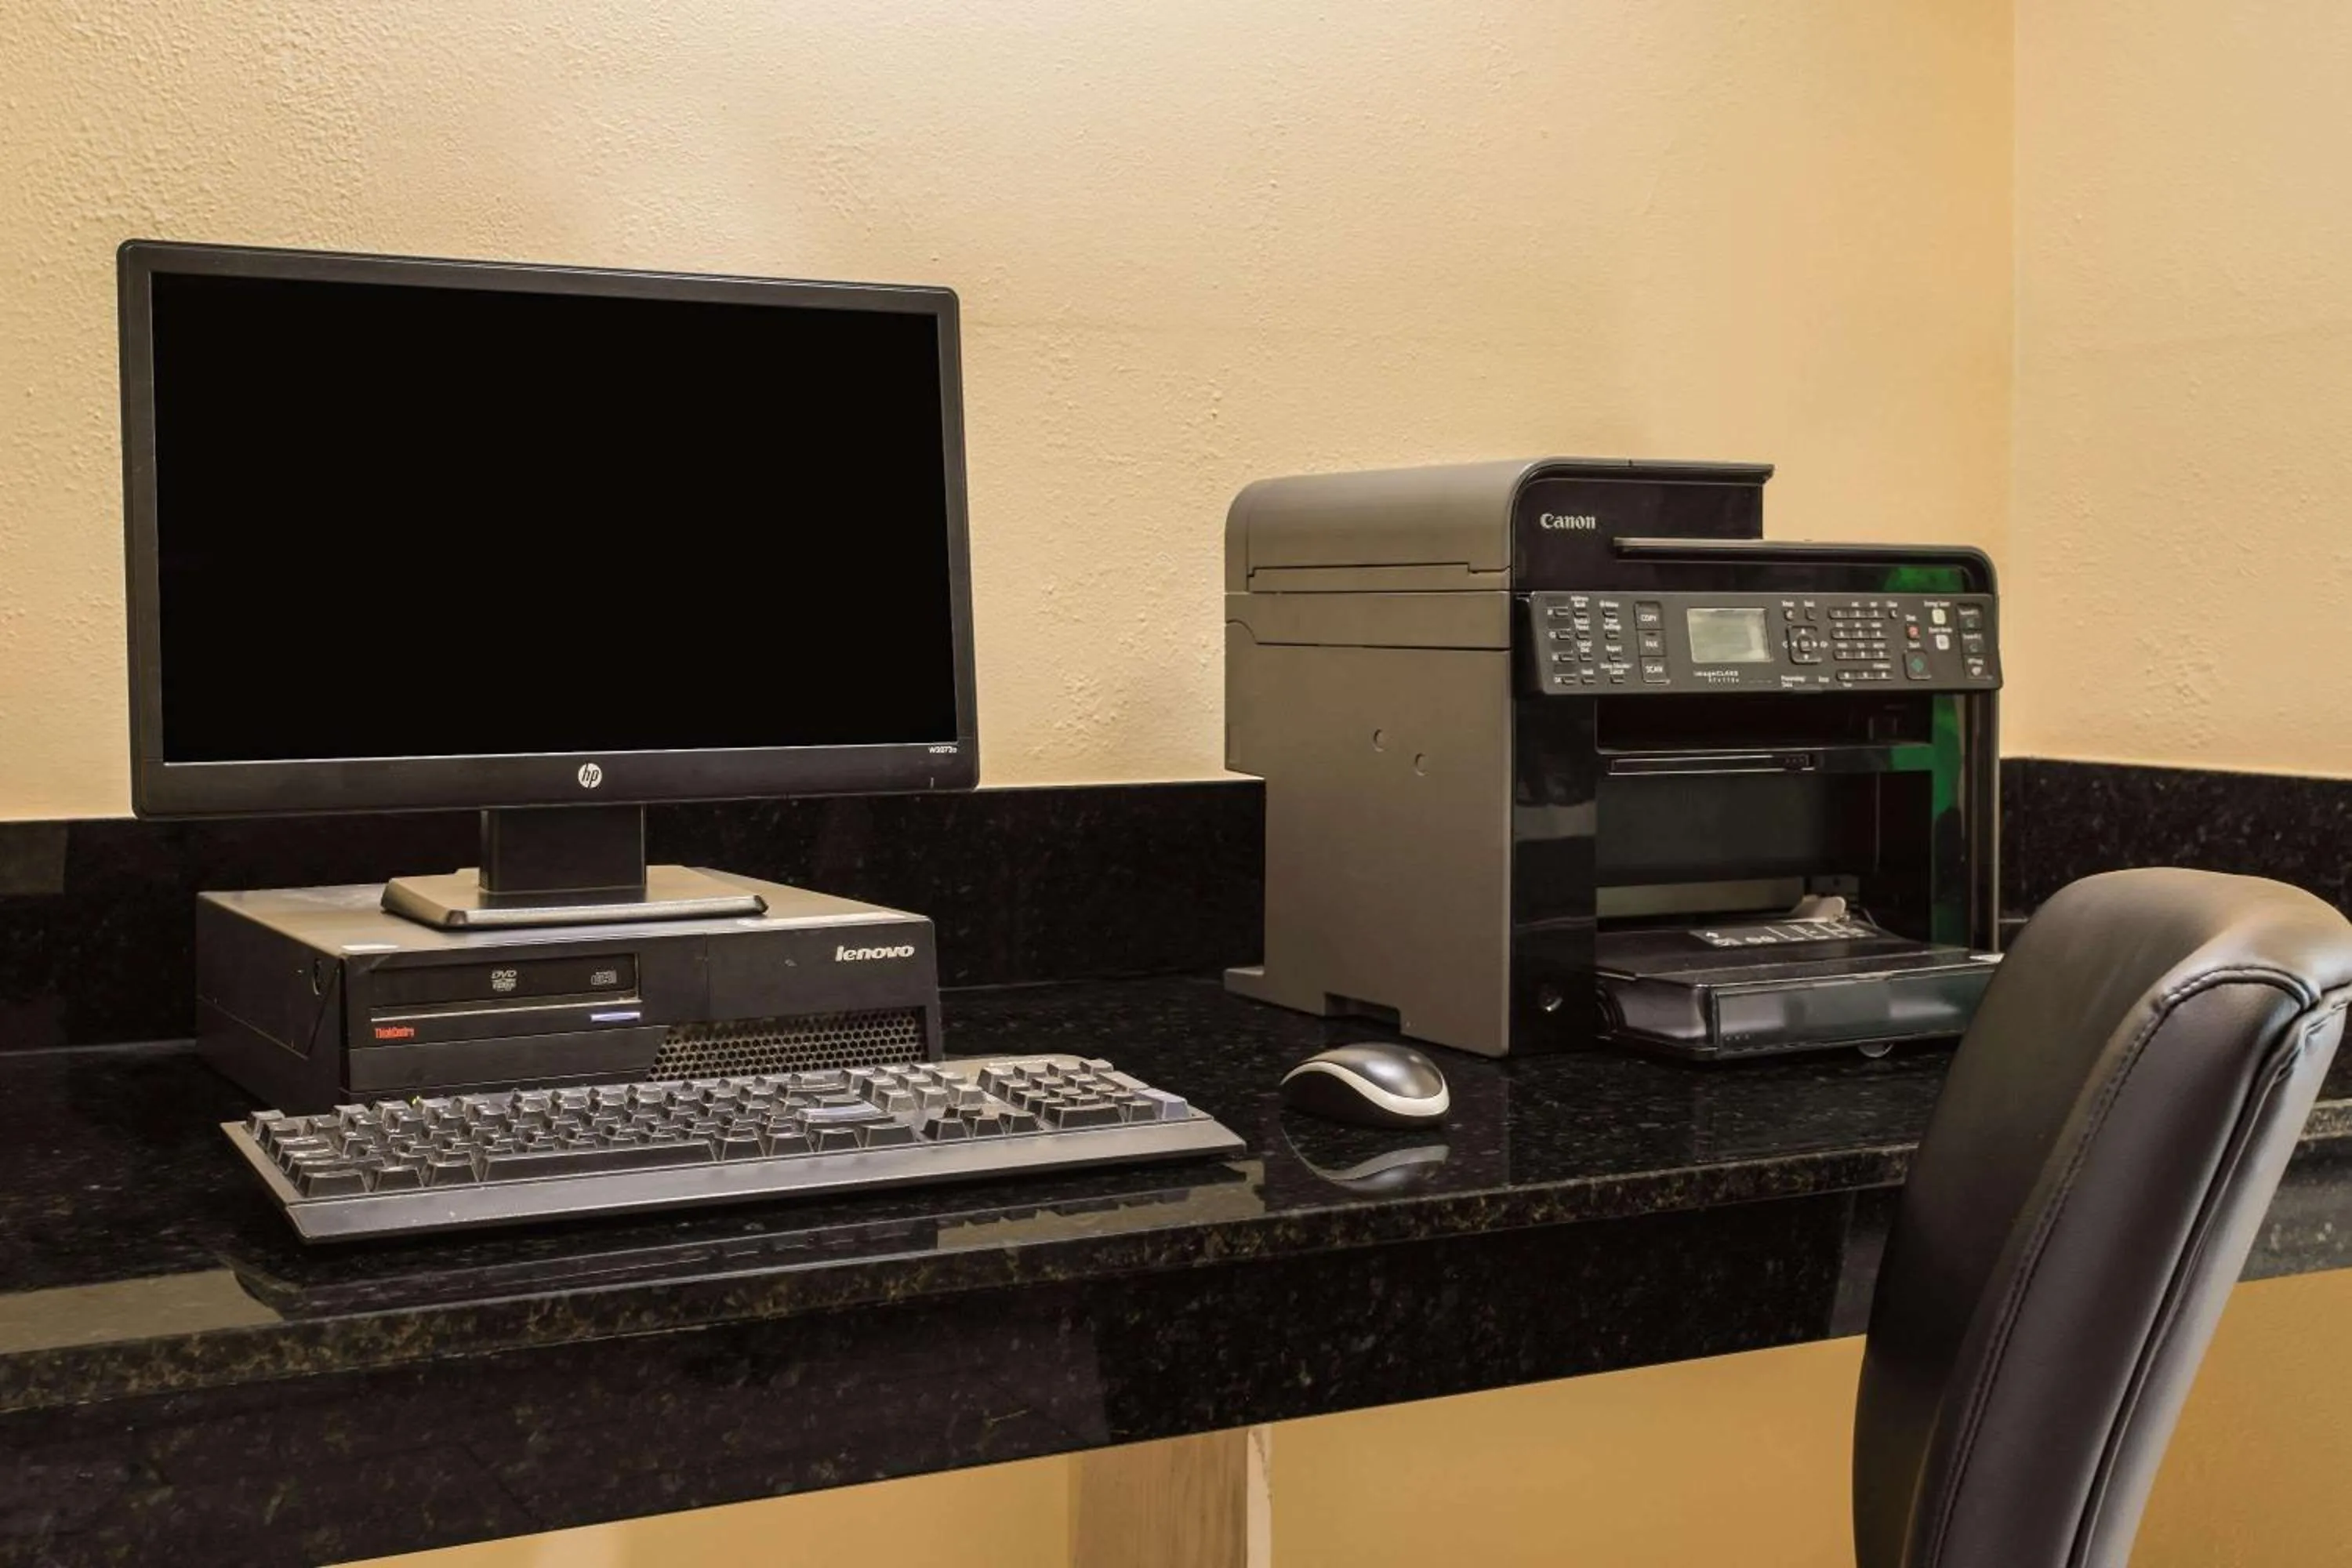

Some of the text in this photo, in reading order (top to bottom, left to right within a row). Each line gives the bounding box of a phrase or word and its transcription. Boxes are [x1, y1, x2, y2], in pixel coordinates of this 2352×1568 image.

[1540, 513, 1595, 529] Canon
[579, 763, 601, 788] hp
[835, 945, 915, 962] lenovo
[491, 970, 517, 978] DVD
